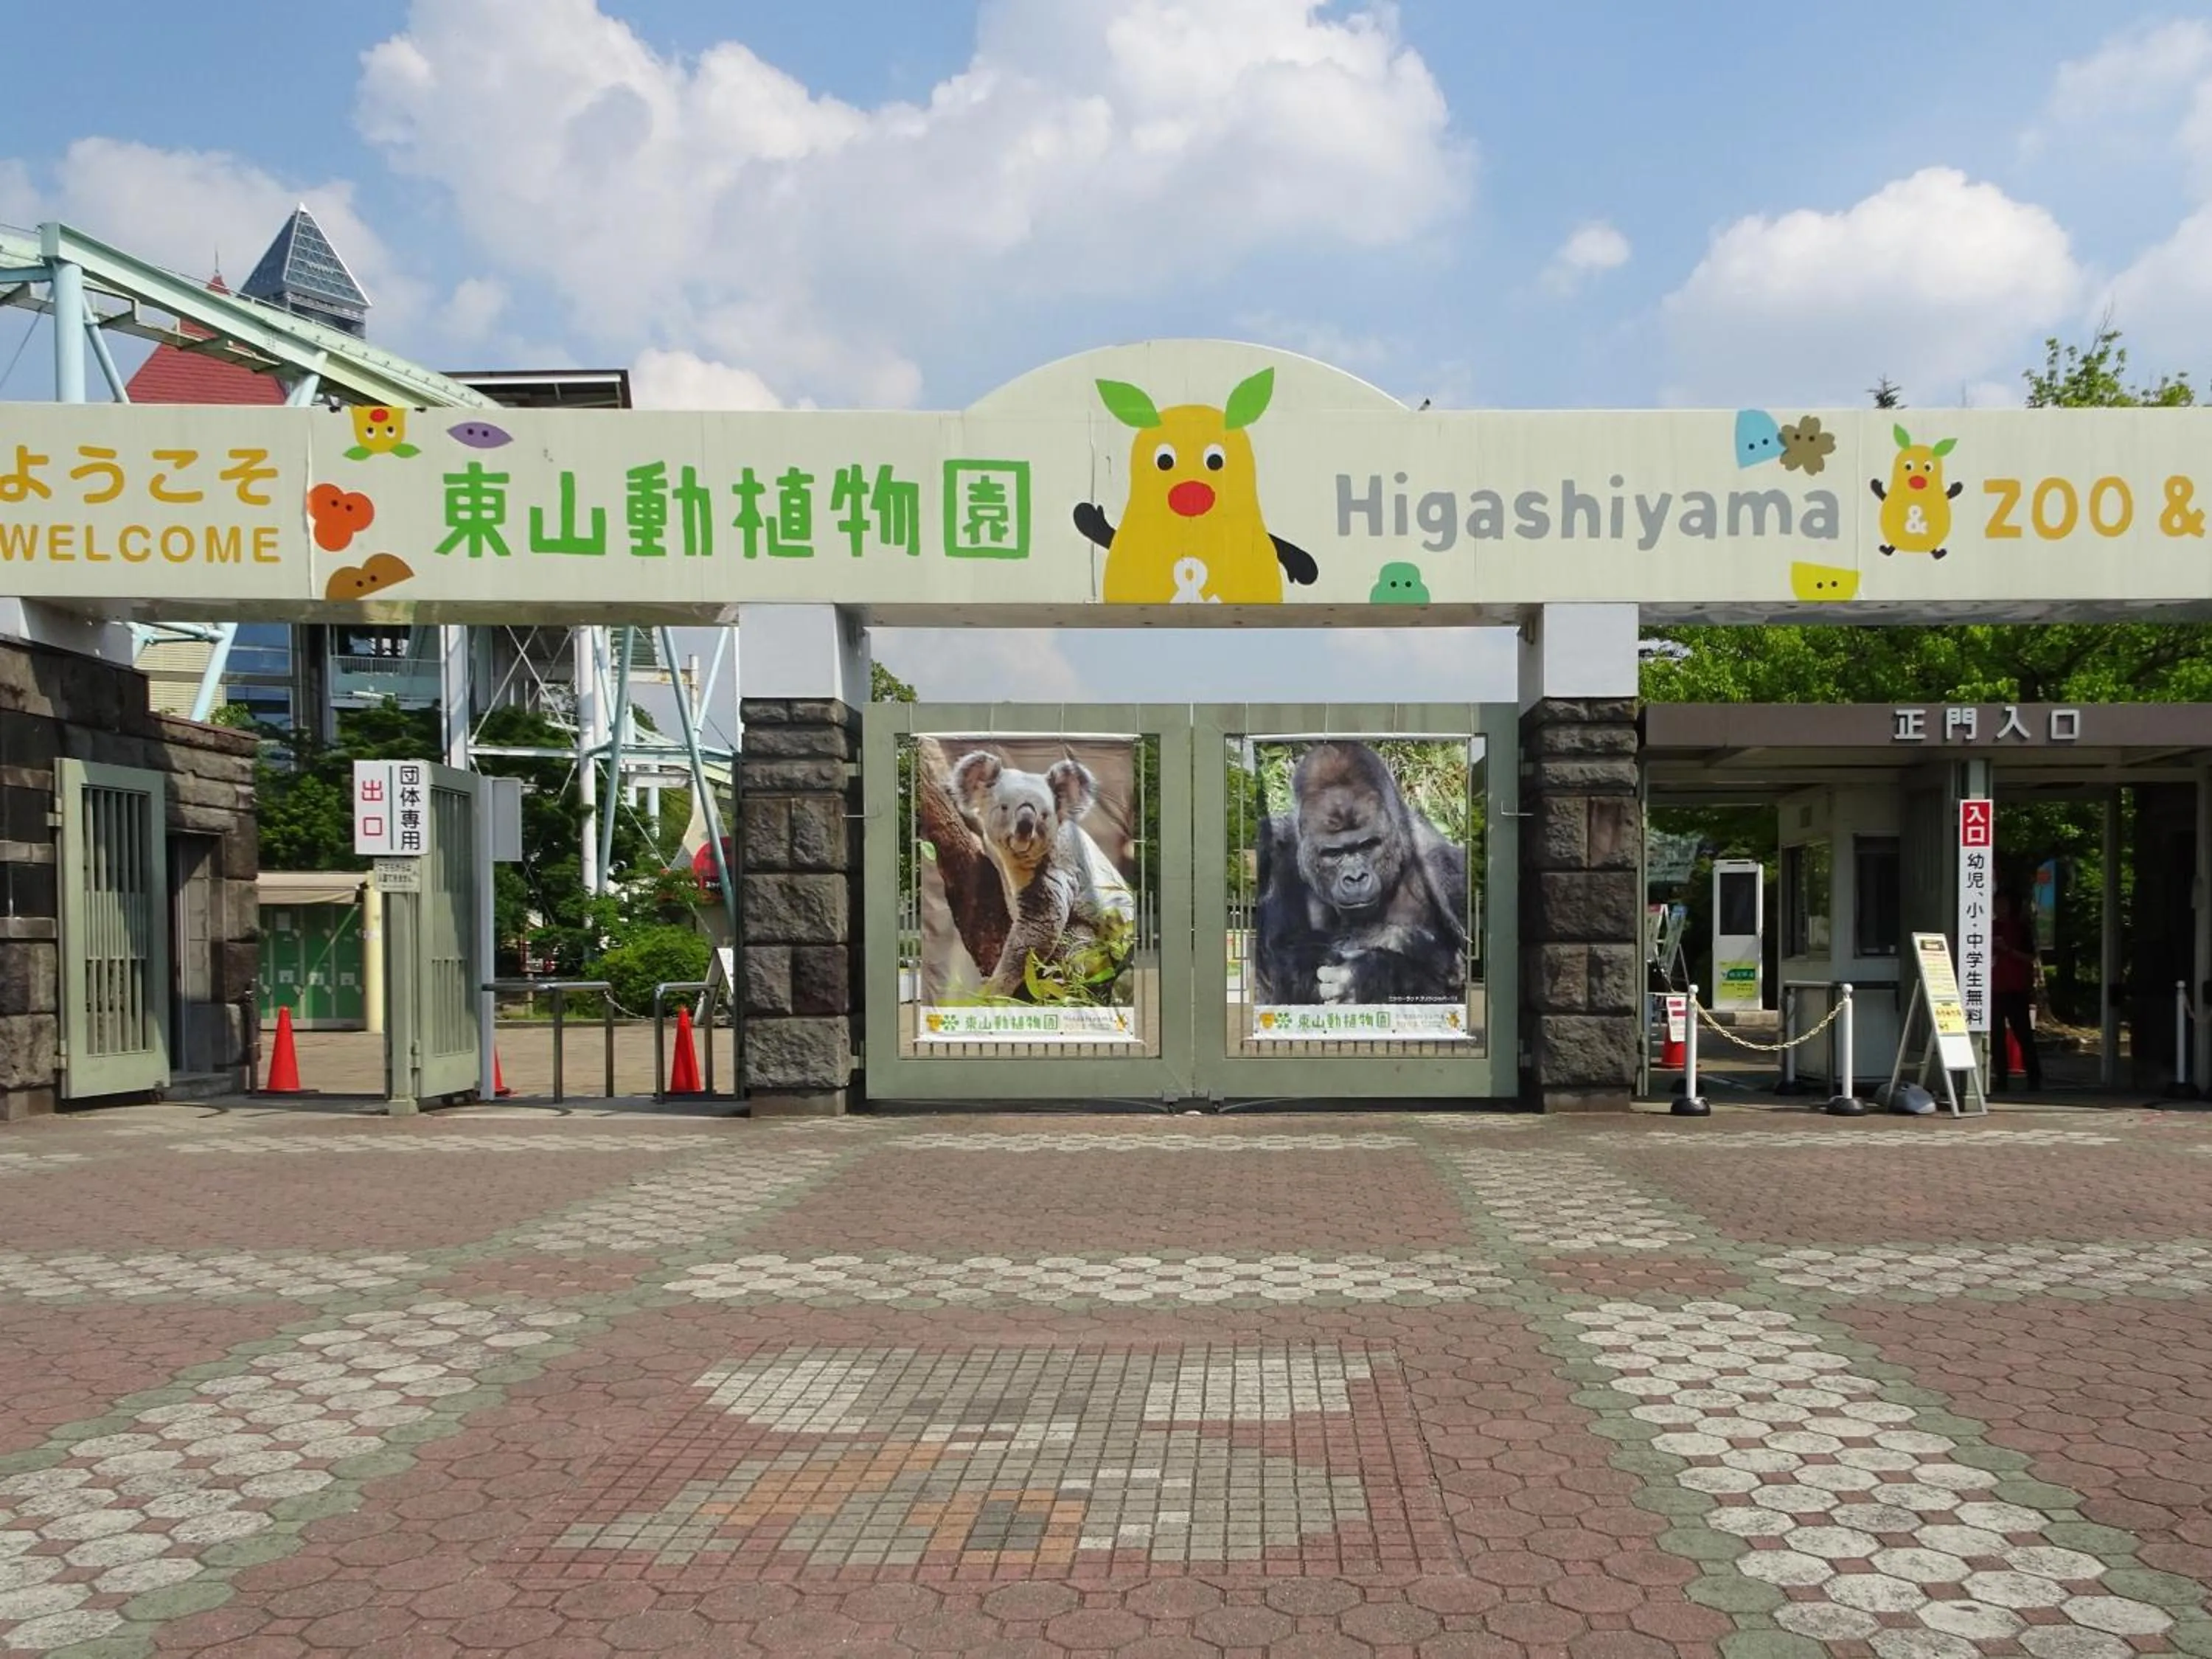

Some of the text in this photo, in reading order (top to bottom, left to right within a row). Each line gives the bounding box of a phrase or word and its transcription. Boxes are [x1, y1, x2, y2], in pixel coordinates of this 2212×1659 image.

[0, 445, 278, 506] ようこそ
[434, 460, 1031, 560] 東山動植物園
[1336, 474, 2206, 552] Higashiyama ZOO &
[0, 524, 281, 563] WELCOME
[1893, 706, 2081, 740] 正門入口
[361, 779, 383, 836] 出口
[400, 765, 421, 851] 団体専用
[1966, 805, 1986, 844] 入口
[964, 1014, 1058, 1030] 東山動植物園
[1298, 1011, 1391, 1029] 東山動植物園
